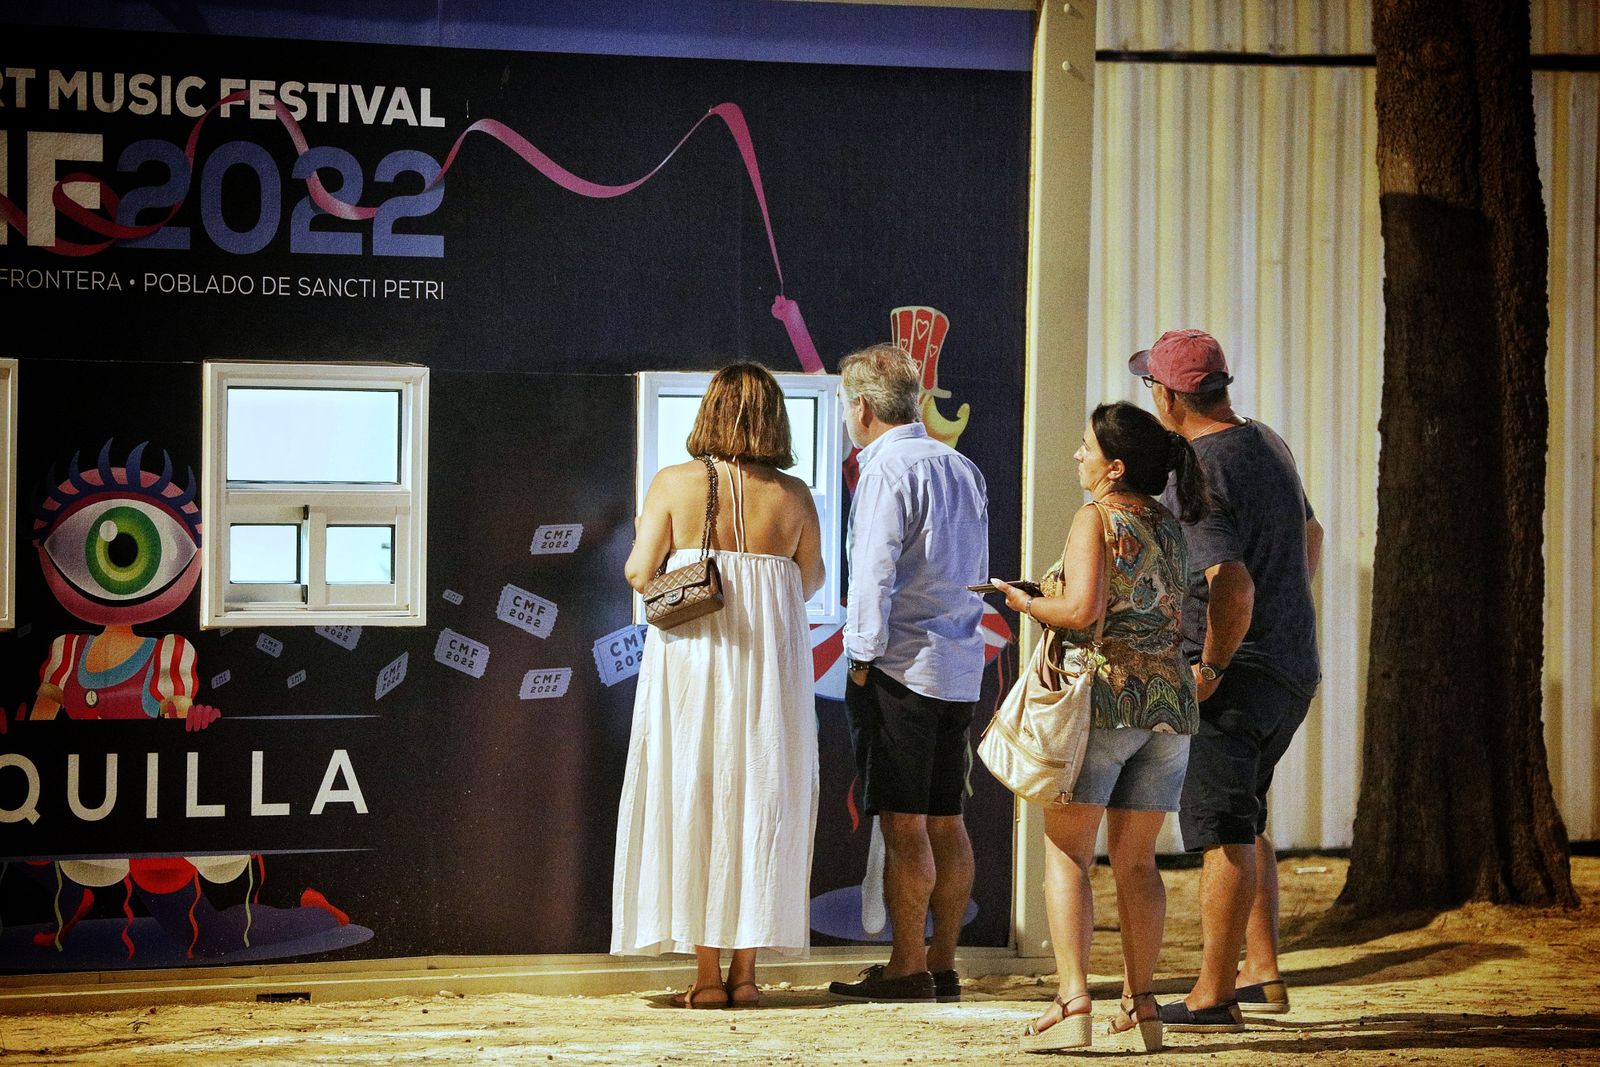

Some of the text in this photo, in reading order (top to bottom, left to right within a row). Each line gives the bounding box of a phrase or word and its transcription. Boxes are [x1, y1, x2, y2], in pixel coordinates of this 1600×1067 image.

[0, 67, 446, 128] T MUSIC FESTIVAL
[144, 272, 255, 296] POBLADO
[262, 276, 291, 296] DE
[298, 277, 376, 298] SANCTI
[384, 280, 445, 300] PETRI
[544, 529, 573, 540] CMF
[541, 540, 569, 549] 2022
[513, 595, 546, 616] CMF
[508, 608, 541, 628] 2022
[449, 639, 479, 658] CMF
[445, 651, 475, 669] 2022
[533, 674, 562, 685] CMF
[530, 685, 558, 694] 2022
